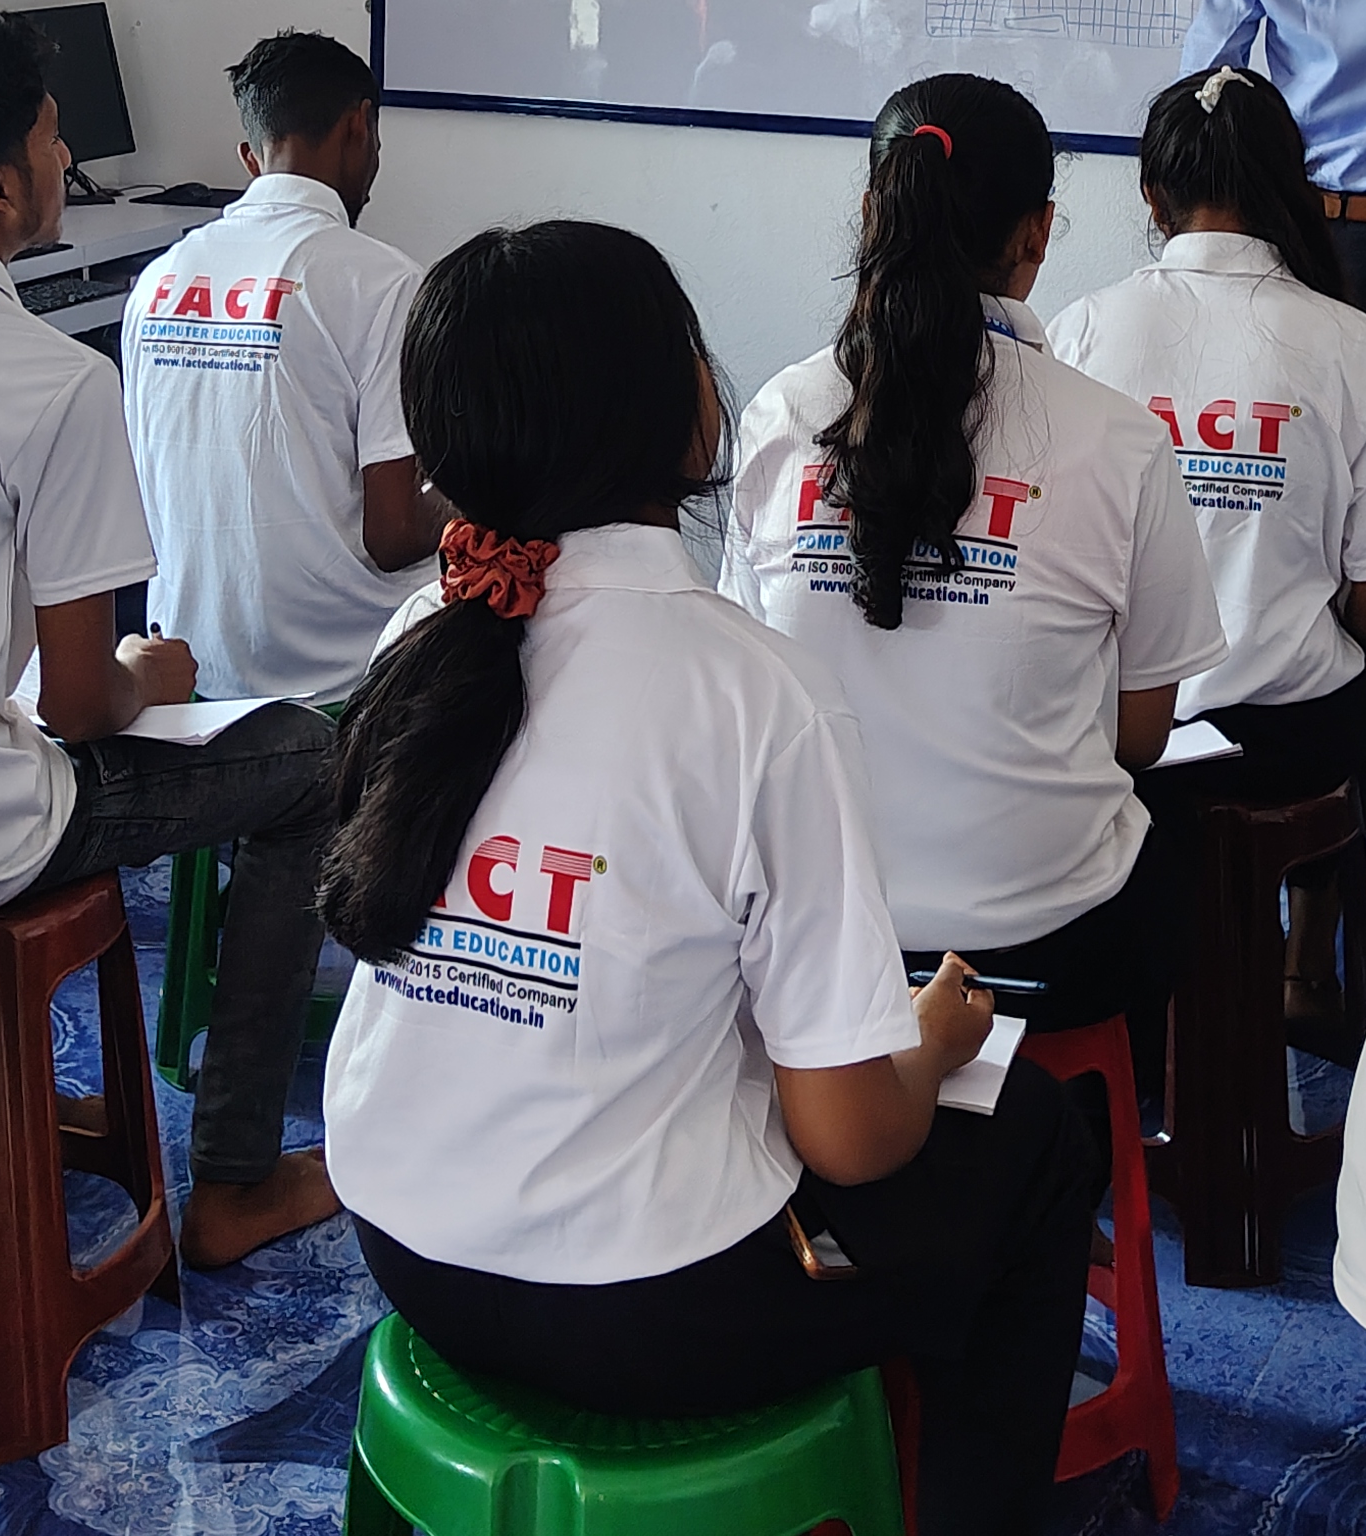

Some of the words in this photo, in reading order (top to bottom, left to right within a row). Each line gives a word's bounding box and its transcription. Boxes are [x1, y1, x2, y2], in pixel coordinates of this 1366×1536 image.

[149, 273, 295, 321] FACT
[141, 323, 209, 340] COMPUTER
[212, 328, 282, 344] EDUCATION
[153, 356, 263, 372] www.facteducation.in
[1146, 395, 1291, 455] ACT
[1184, 480, 1230, 495] Certified
[1232, 484, 1284, 501] Company
[1187, 458, 1286, 490] EDUCATION
[791, 560, 806, 574] An
[808, 560, 829, 574] ISO
[953, 572, 1017, 593] Company
[452, 929, 580, 977] EDUCATION
[446, 965, 504, 995] Certified
[506, 981, 578, 1014] Company
